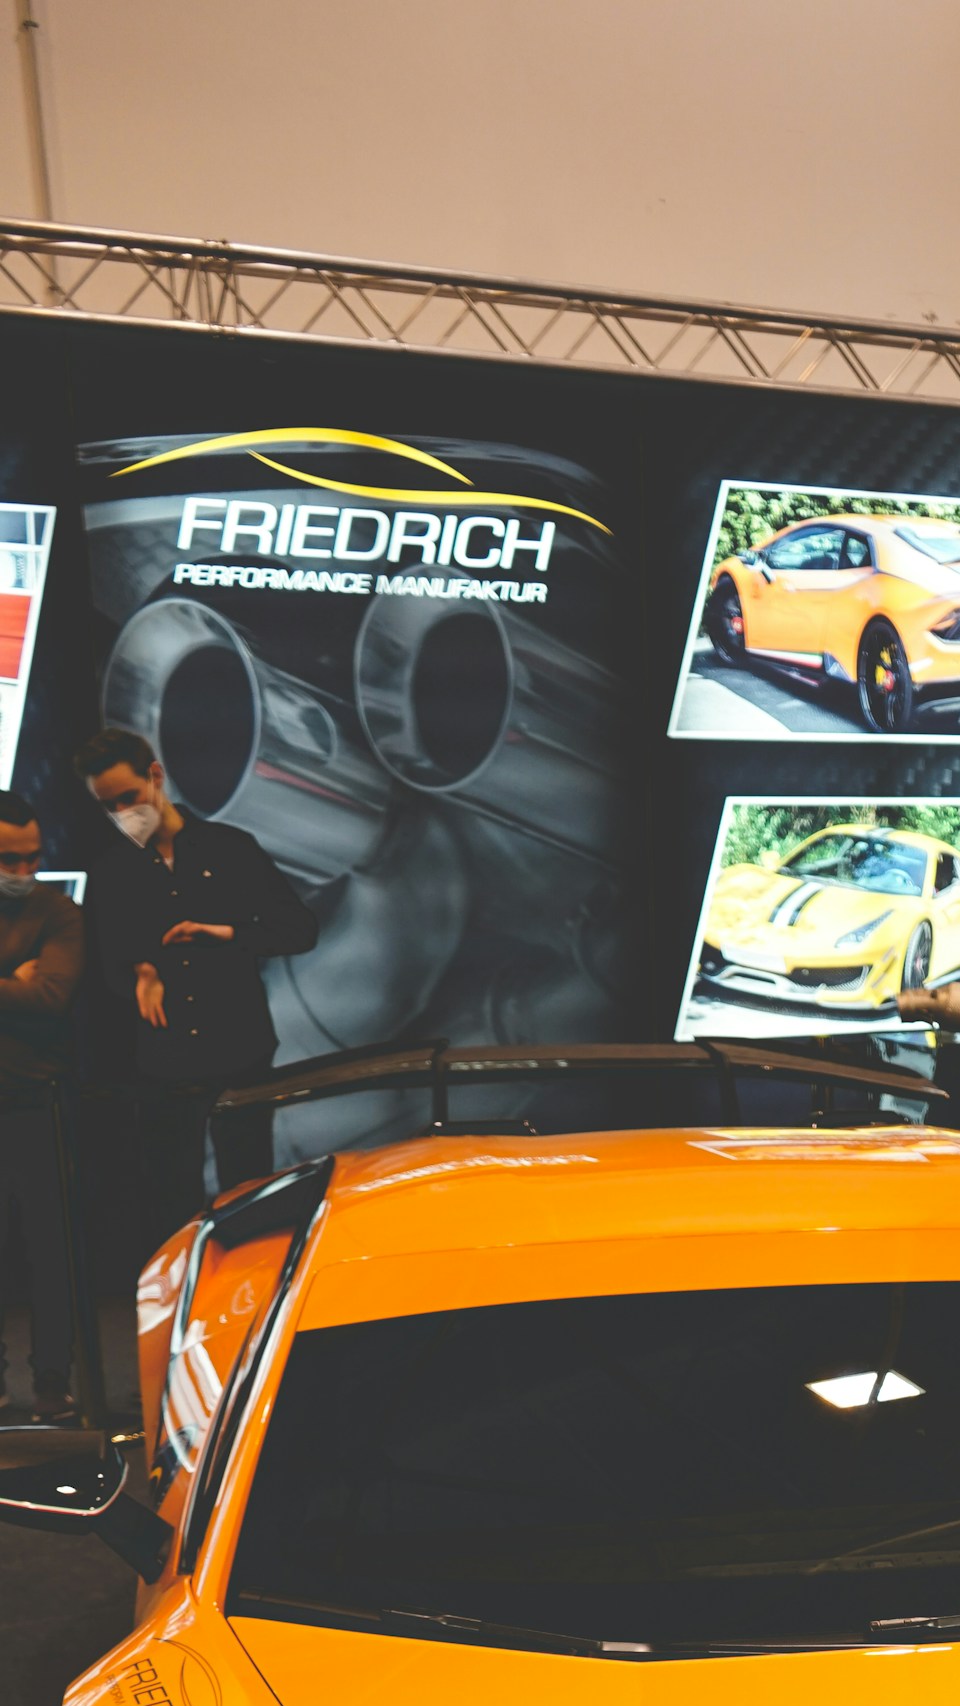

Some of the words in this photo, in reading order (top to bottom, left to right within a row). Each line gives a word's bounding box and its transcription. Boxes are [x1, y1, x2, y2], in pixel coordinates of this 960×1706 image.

[177, 496, 556, 572] FRIEDRICH
[173, 563, 374, 595] PERFORMANCE
[376, 574, 549, 603] MANUFAKTUR
